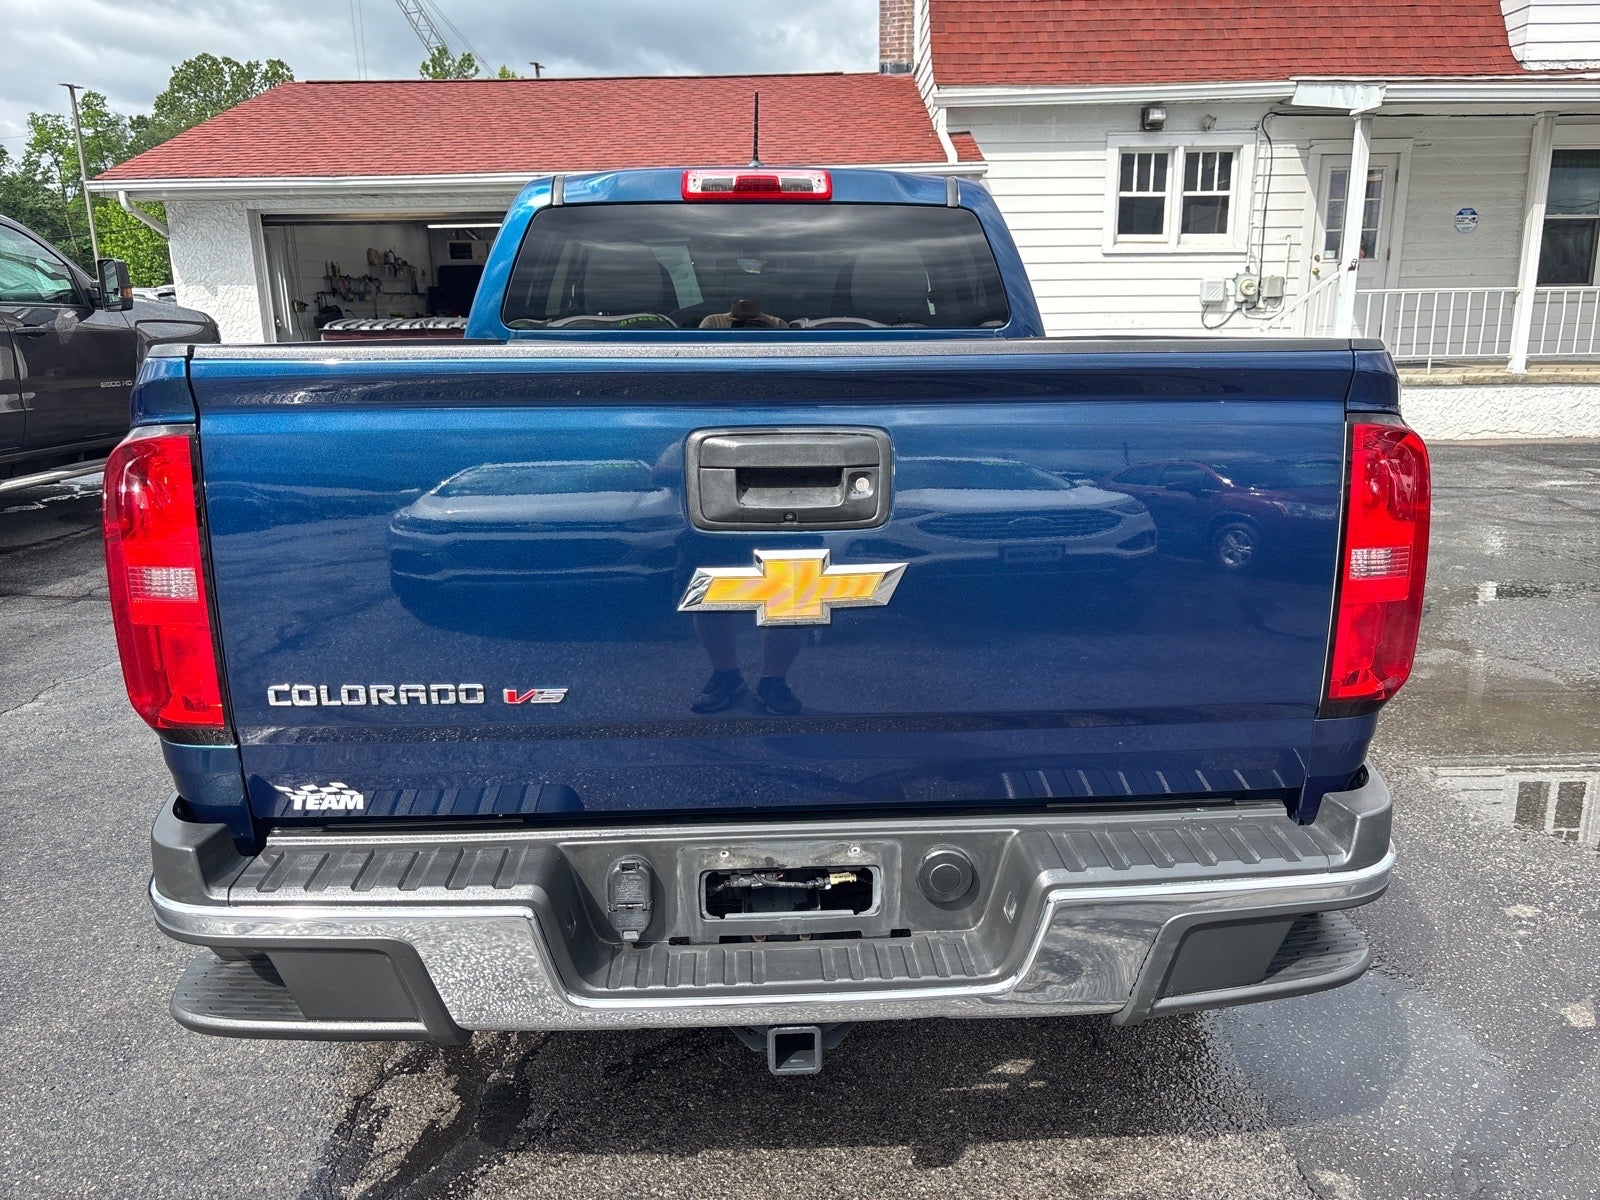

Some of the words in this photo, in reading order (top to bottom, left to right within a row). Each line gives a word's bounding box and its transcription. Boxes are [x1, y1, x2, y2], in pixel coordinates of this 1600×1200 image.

[267, 683, 484, 706] COLORADO
[503, 688, 568, 704] V6
[290, 794, 364, 810] TEAM
